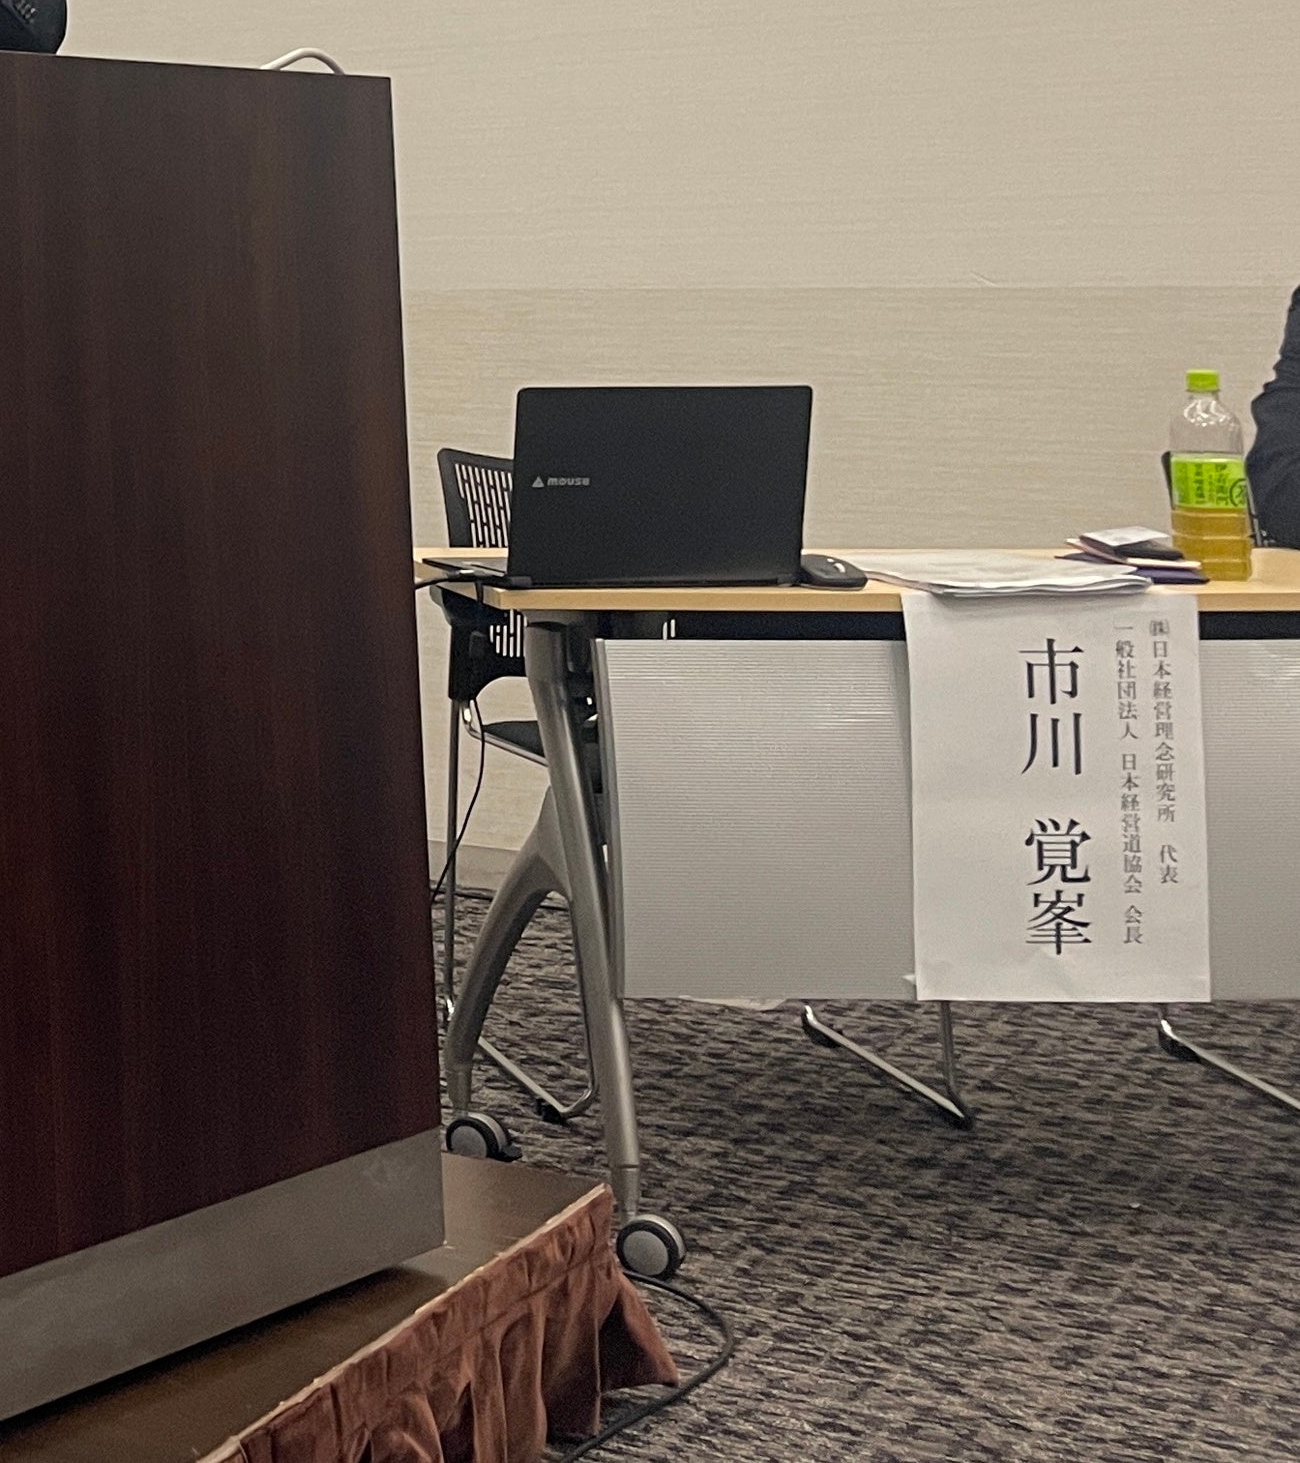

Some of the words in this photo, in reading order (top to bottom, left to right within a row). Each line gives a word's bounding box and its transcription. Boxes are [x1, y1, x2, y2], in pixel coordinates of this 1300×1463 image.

[1019, 638, 1085, 776] 市川
[1114, 624, 1139, 740] 一般社団法人
[1024, 817, 1093, 956] 覚峯
[1120, 753, 1143, 895] 日本経営道協会
[1159, 844, 1179, 885] 代表
[1123, 904, 1144, 945] 会長
